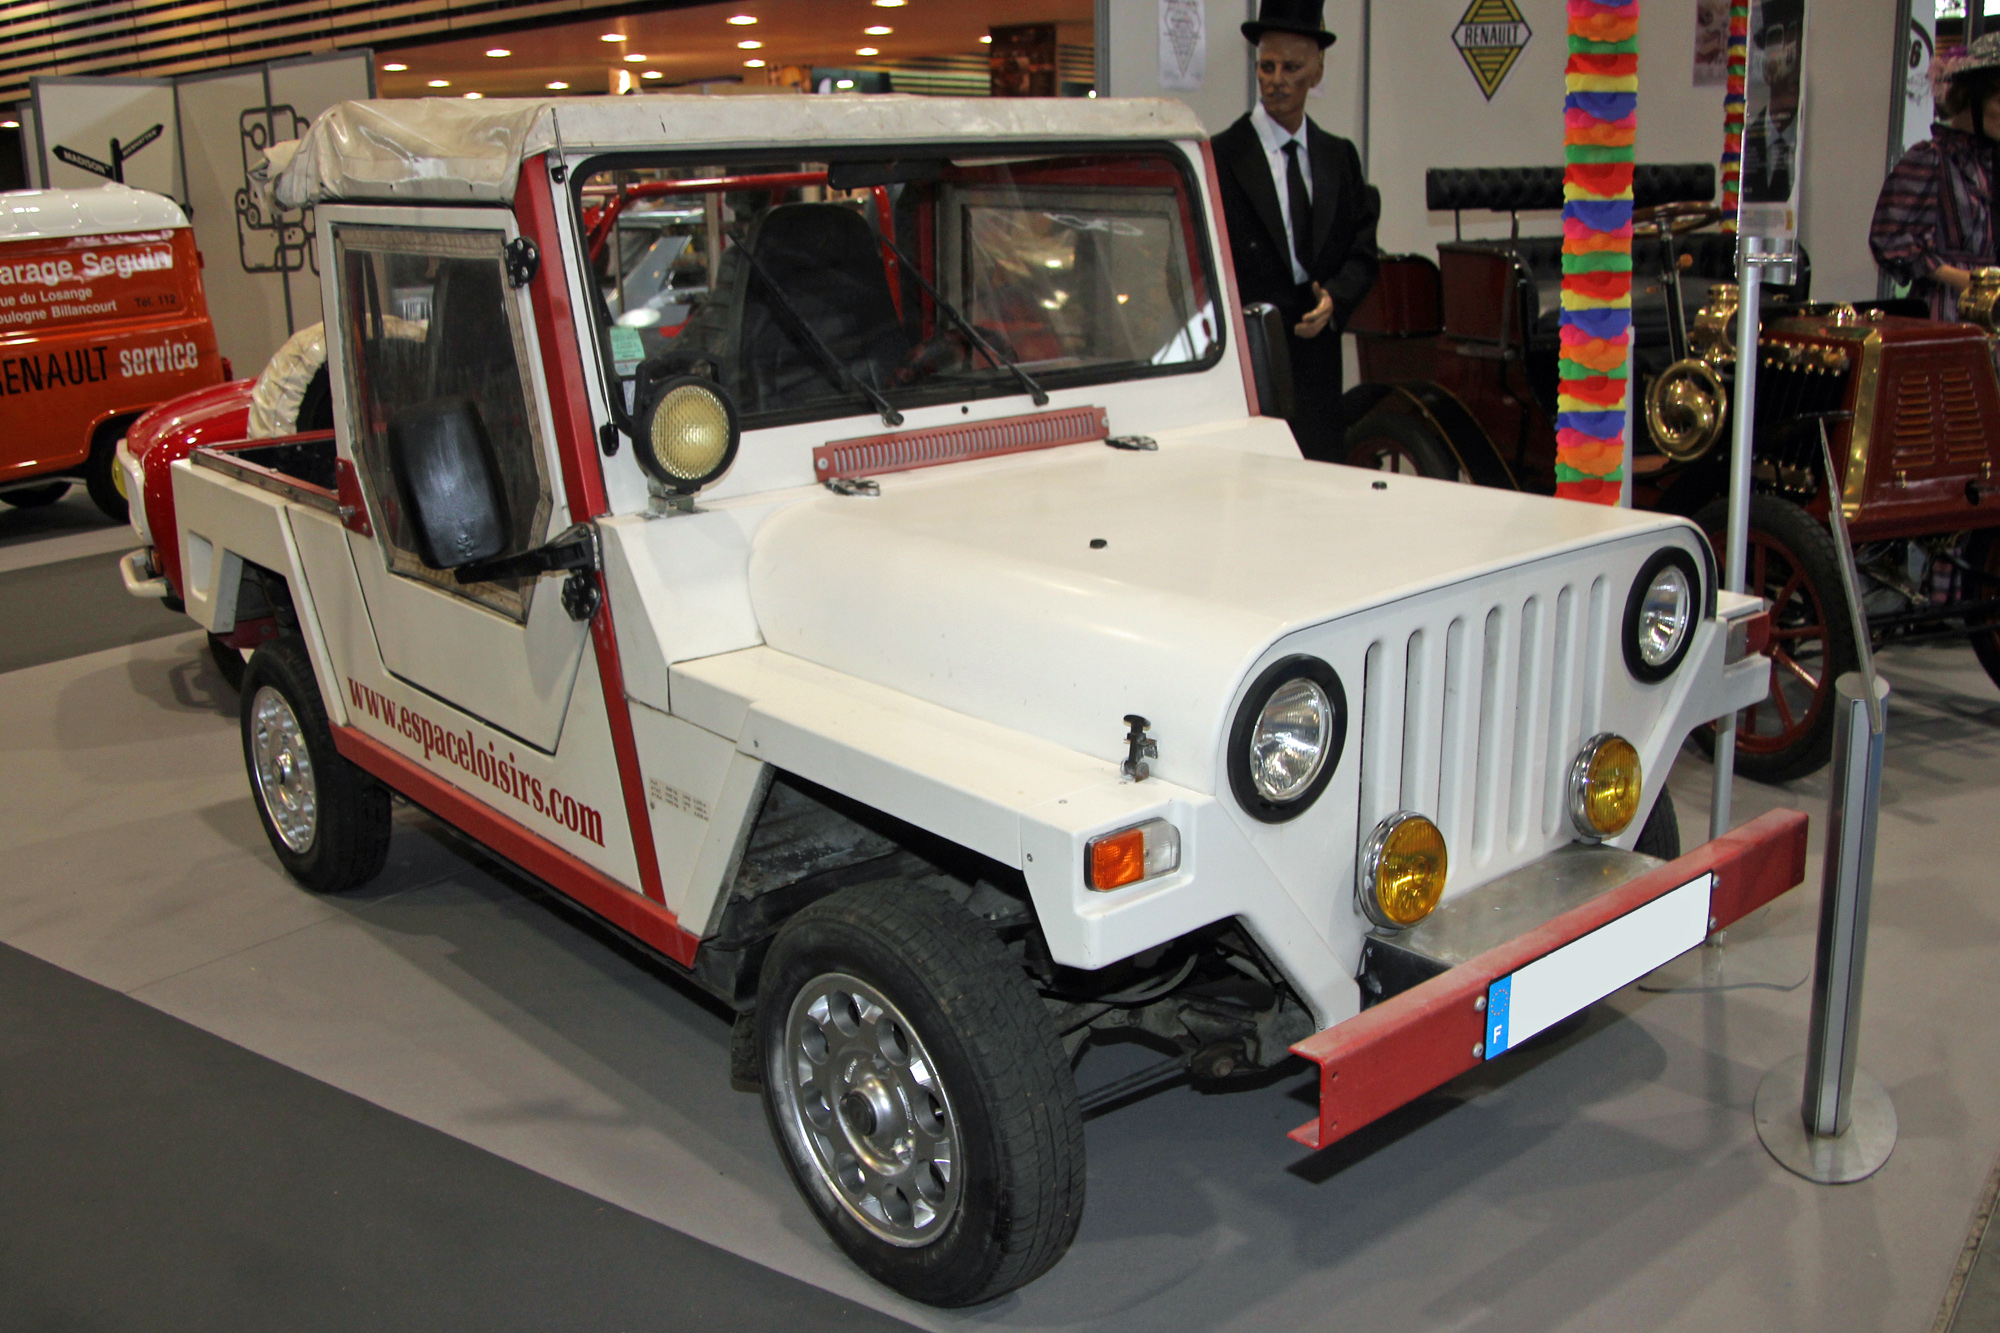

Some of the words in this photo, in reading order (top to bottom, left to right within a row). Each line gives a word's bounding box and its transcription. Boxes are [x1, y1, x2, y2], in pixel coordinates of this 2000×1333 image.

[1464, 24, 1519, 45] RENAULT
[1908, 39, 1923, 69] 6
[62, 149, 107, 175] MADISON
[0, 260, 74, 287] arage
[81, 247, 173, 279] Seguin
[0, 295, 16, 308] ue
[19, 291, 37, 305] du
[39, 286, 93, 303] Losange
[158, 293, 176, 305] 112
[0, 308, 48, 325] oulogne
[51, 300, 118, 319] Billancourt
[0, 345, 107, 396] ENAULT
[119, 338, 199, 378] service
[347, 676, 605, 848] www.espaceloisirs.com
[1493, 1024, 1503, 1044] F
